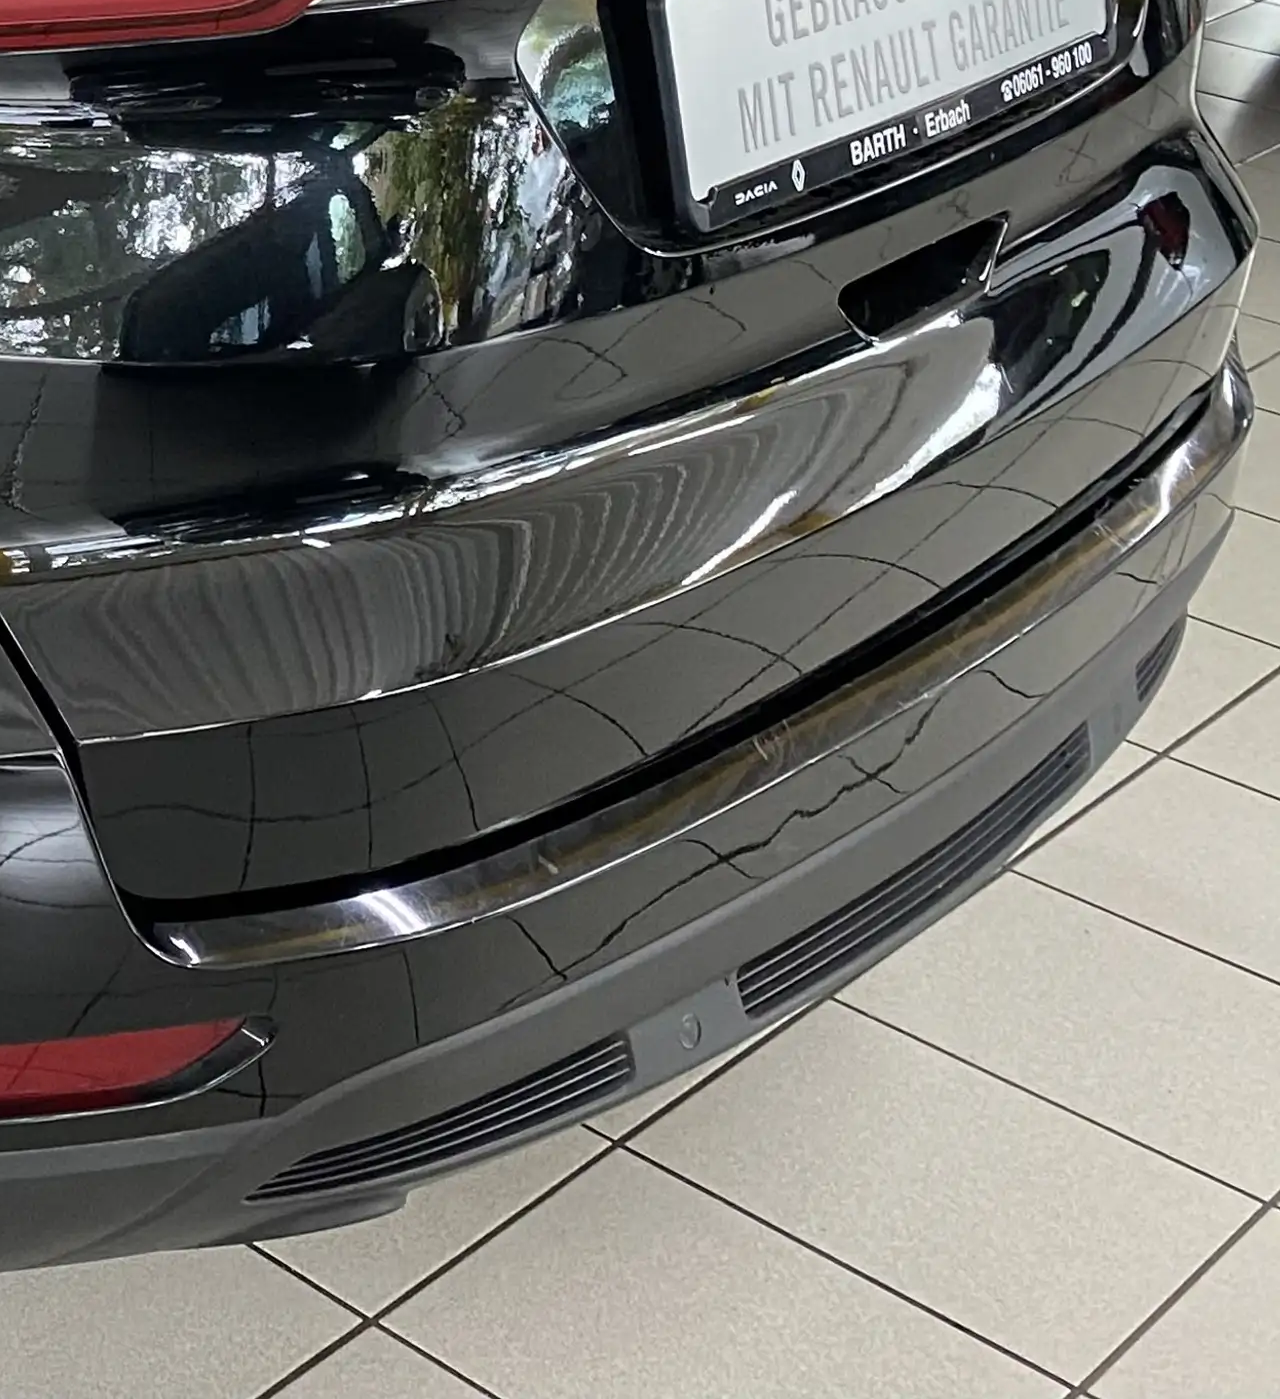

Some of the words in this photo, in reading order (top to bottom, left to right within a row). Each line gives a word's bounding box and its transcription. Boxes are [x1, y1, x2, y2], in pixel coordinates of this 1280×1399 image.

[737, 71, 798, 154] MIT
[808, 19, 941, 128] RENAULT
[1012, 63, 1044, 97] 06061
[1051, 50, 1072, 79] 960
[1072, 41, 1093, 69] 100
[849, 124, 907, 167] BARTH
[924, 99, 972, 138] Erbach
[734, 180, 778, 206] DACIA
